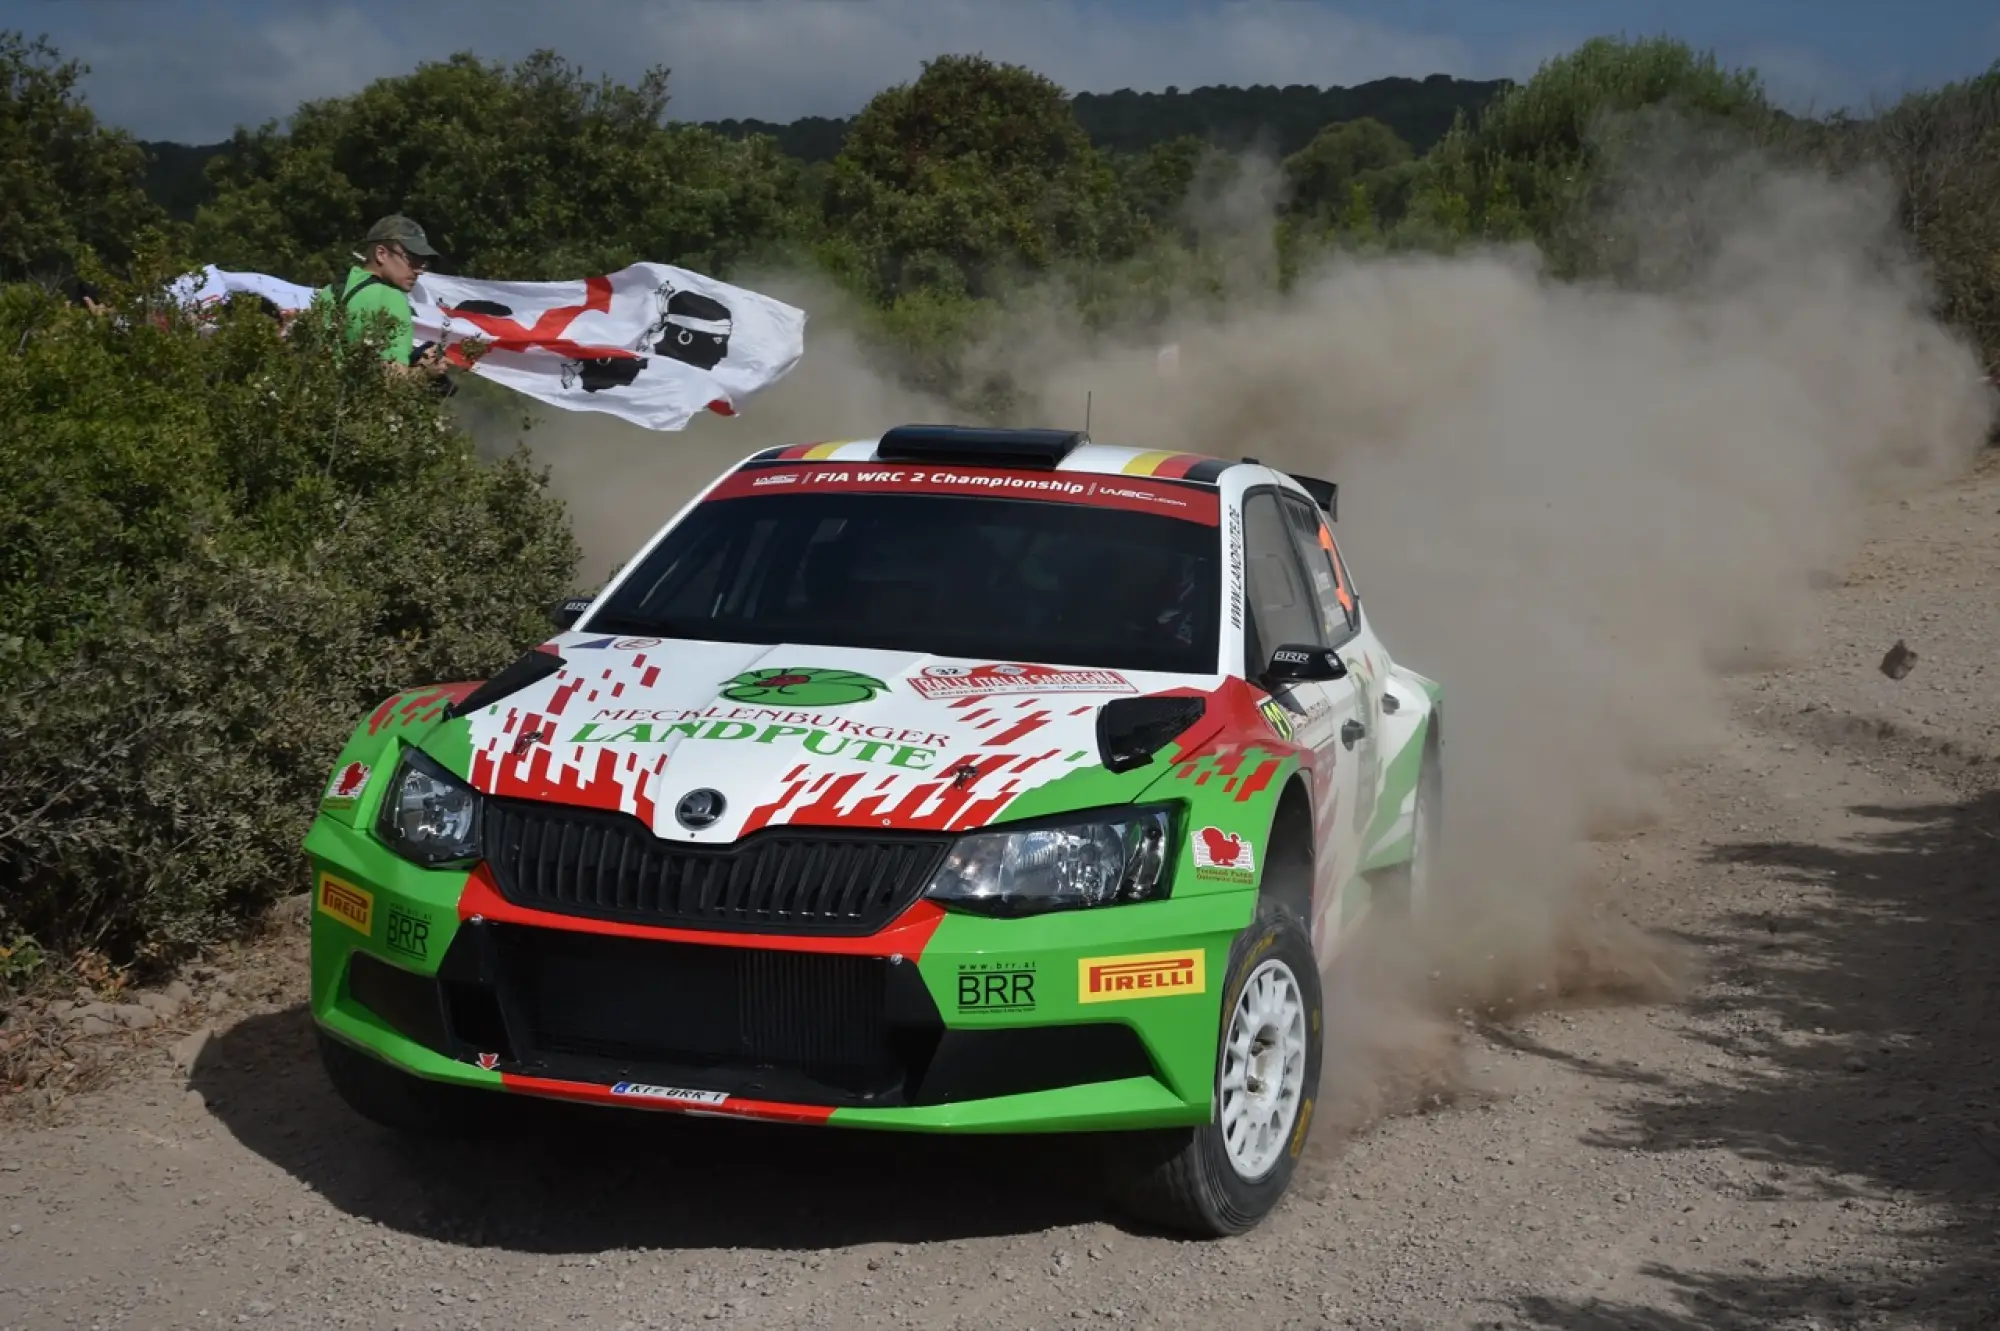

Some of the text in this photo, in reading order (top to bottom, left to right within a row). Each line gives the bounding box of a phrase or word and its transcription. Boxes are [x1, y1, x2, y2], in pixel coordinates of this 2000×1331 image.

[814, 472, 850, 482] FIA
[857, 472, 905, 482] WRC
[910, 473, 925, 482] 2
[930, 473, 1084, 494] Championship
[1274, 651, 1310, 664] BRR
[919, 677, 974, 692] RALLY
[973, 675, 1030, 688] ITALIA
[1031, 671, 1121, 686] SARDEGNA
[592, 706, 951, 748] MECKLENBURGER
[567, 720, 938, 770] LANDPUTE
[323, 879, 369, 925] PIRELLI
[387, 913, 429, 954] BRR
[958, 961, 1036, 970] www.brr.at
[1089, 958, 1194, 992] PIRELLI
[958, 974, 1036, 1005] BRR
